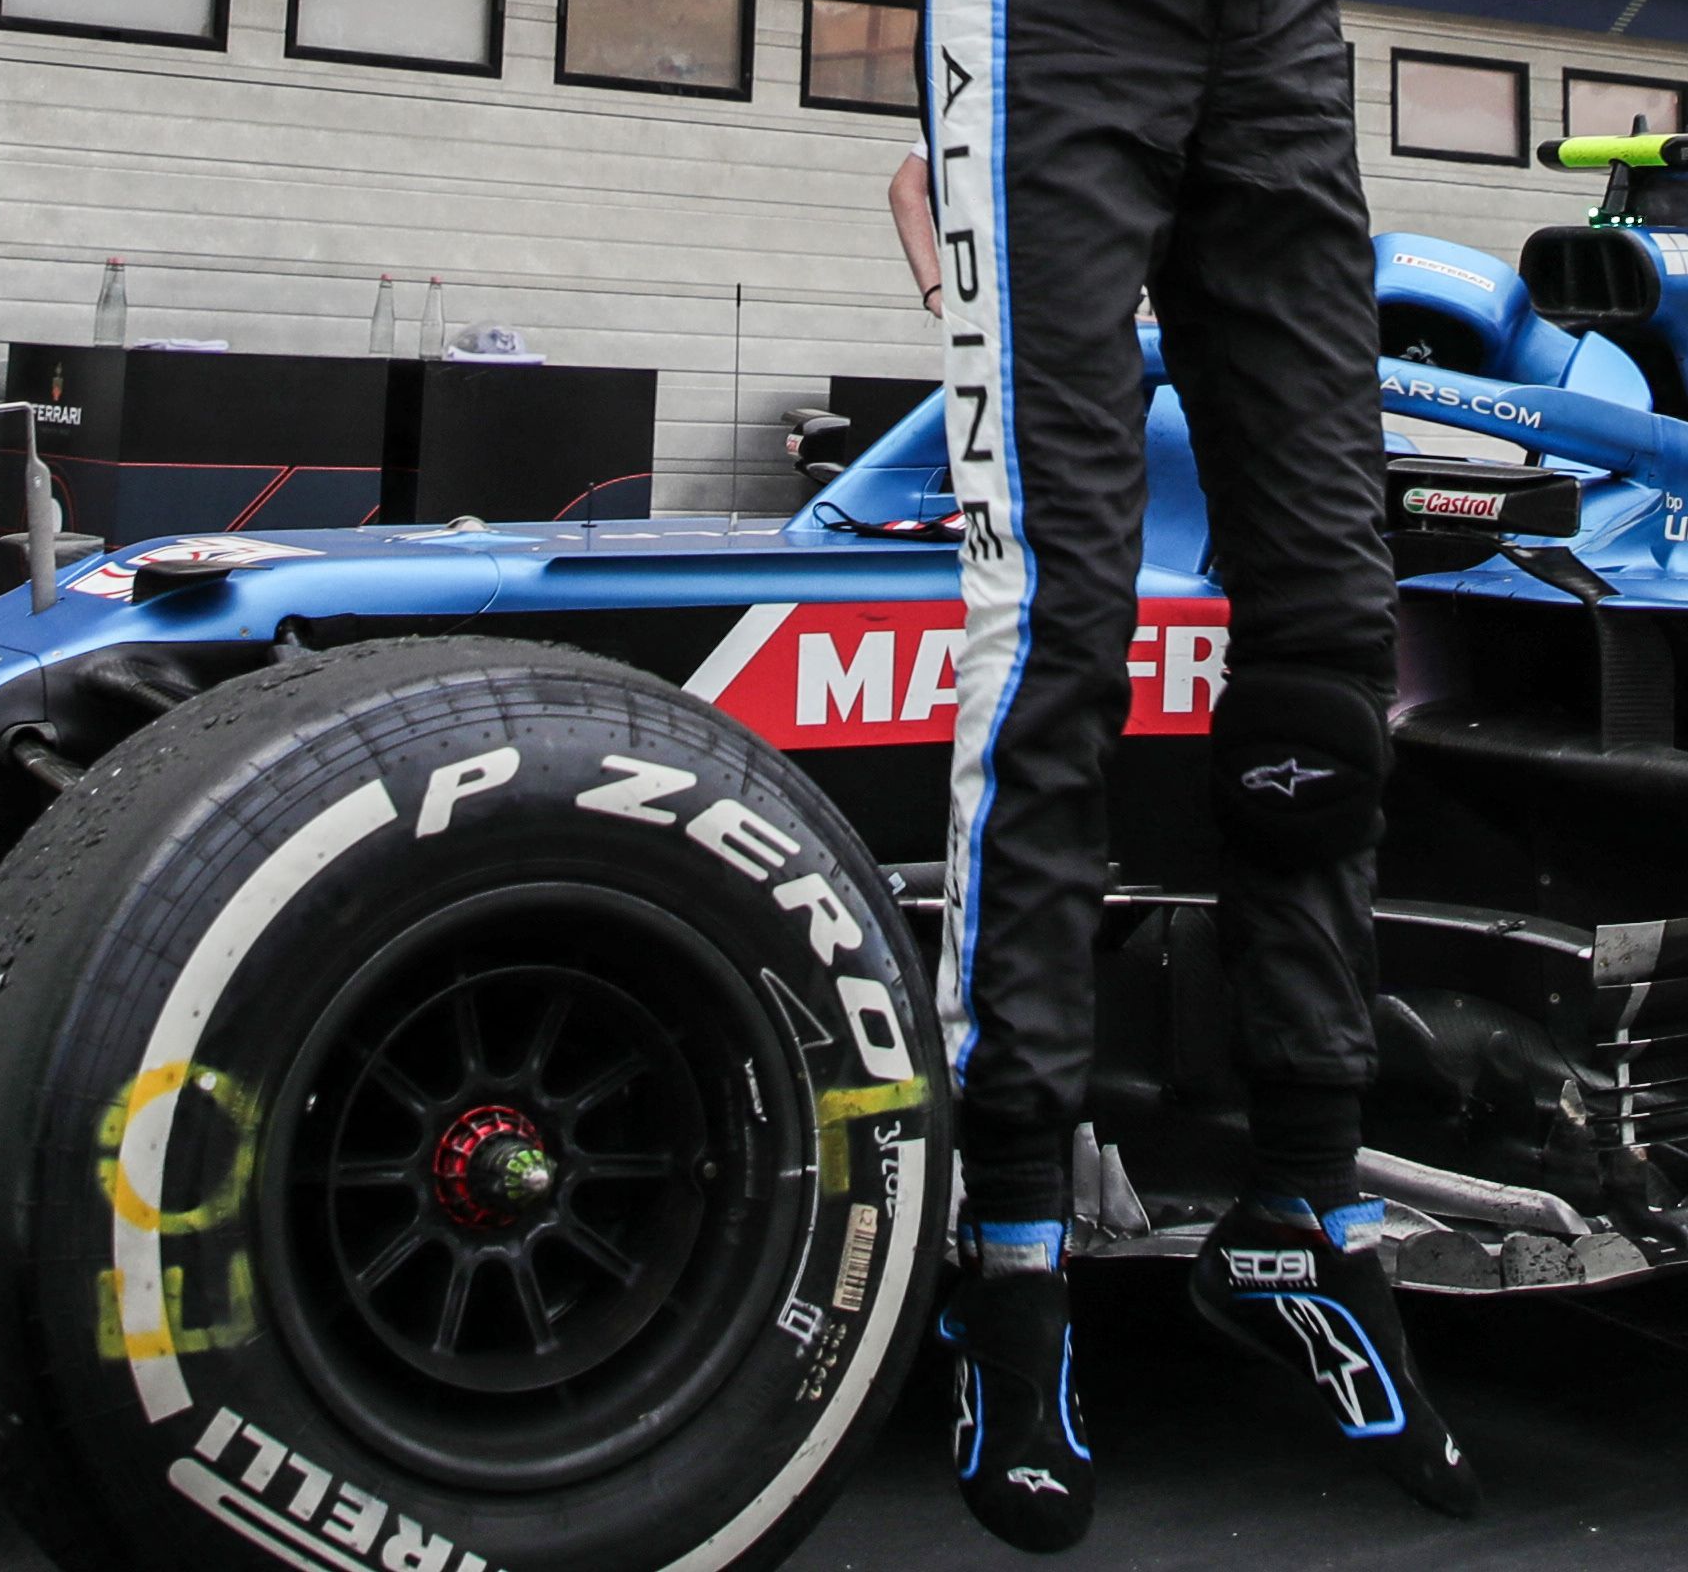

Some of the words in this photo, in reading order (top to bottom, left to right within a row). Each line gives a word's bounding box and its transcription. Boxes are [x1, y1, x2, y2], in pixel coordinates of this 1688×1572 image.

[941, 44, 1005, 563] ALPINE
[32, 403, 82, 426] FERRARI
[1425, 492, 1498, 517] Castrol
[1665, 492, 1683, 513] bp
[416, 746, 520, 838] P
[575, 754, 914, 1081] ZERO
